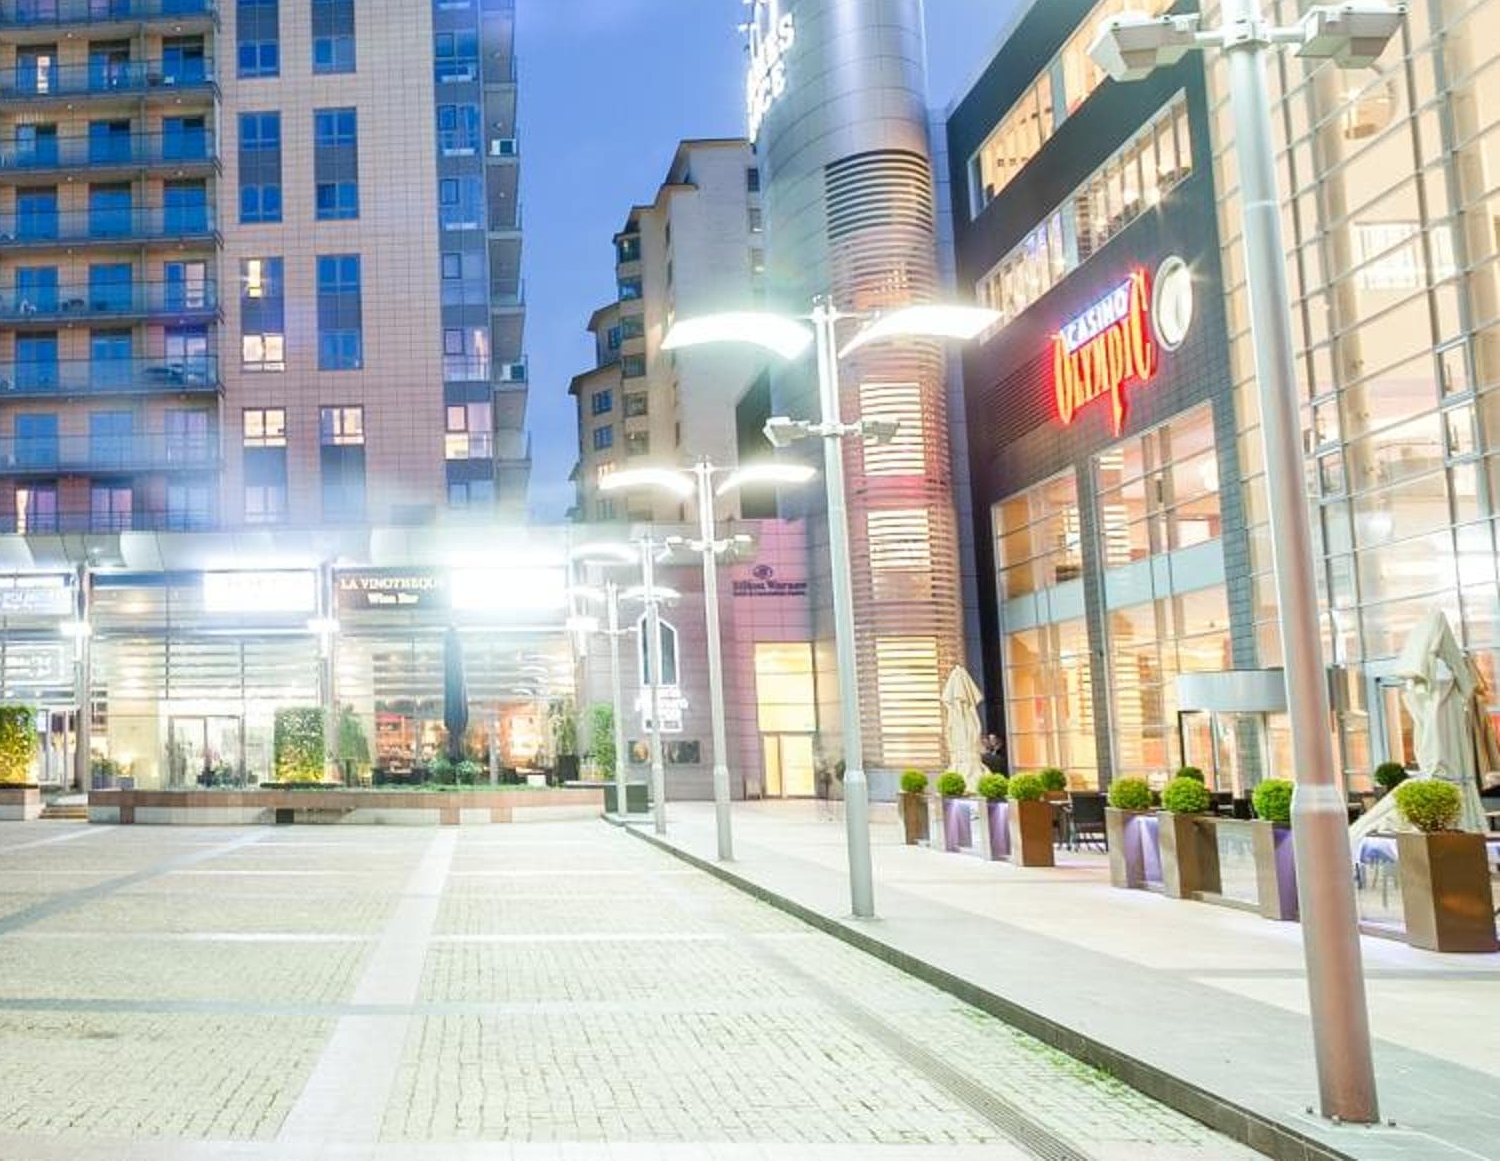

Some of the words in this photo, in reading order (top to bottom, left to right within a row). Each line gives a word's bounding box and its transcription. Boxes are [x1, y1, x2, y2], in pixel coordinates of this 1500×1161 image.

[1066, 289, 1127, 347] CASINO
[1053, 268, 1154, 438] OLYMPIC
[340, 578, 358, 590] LA
